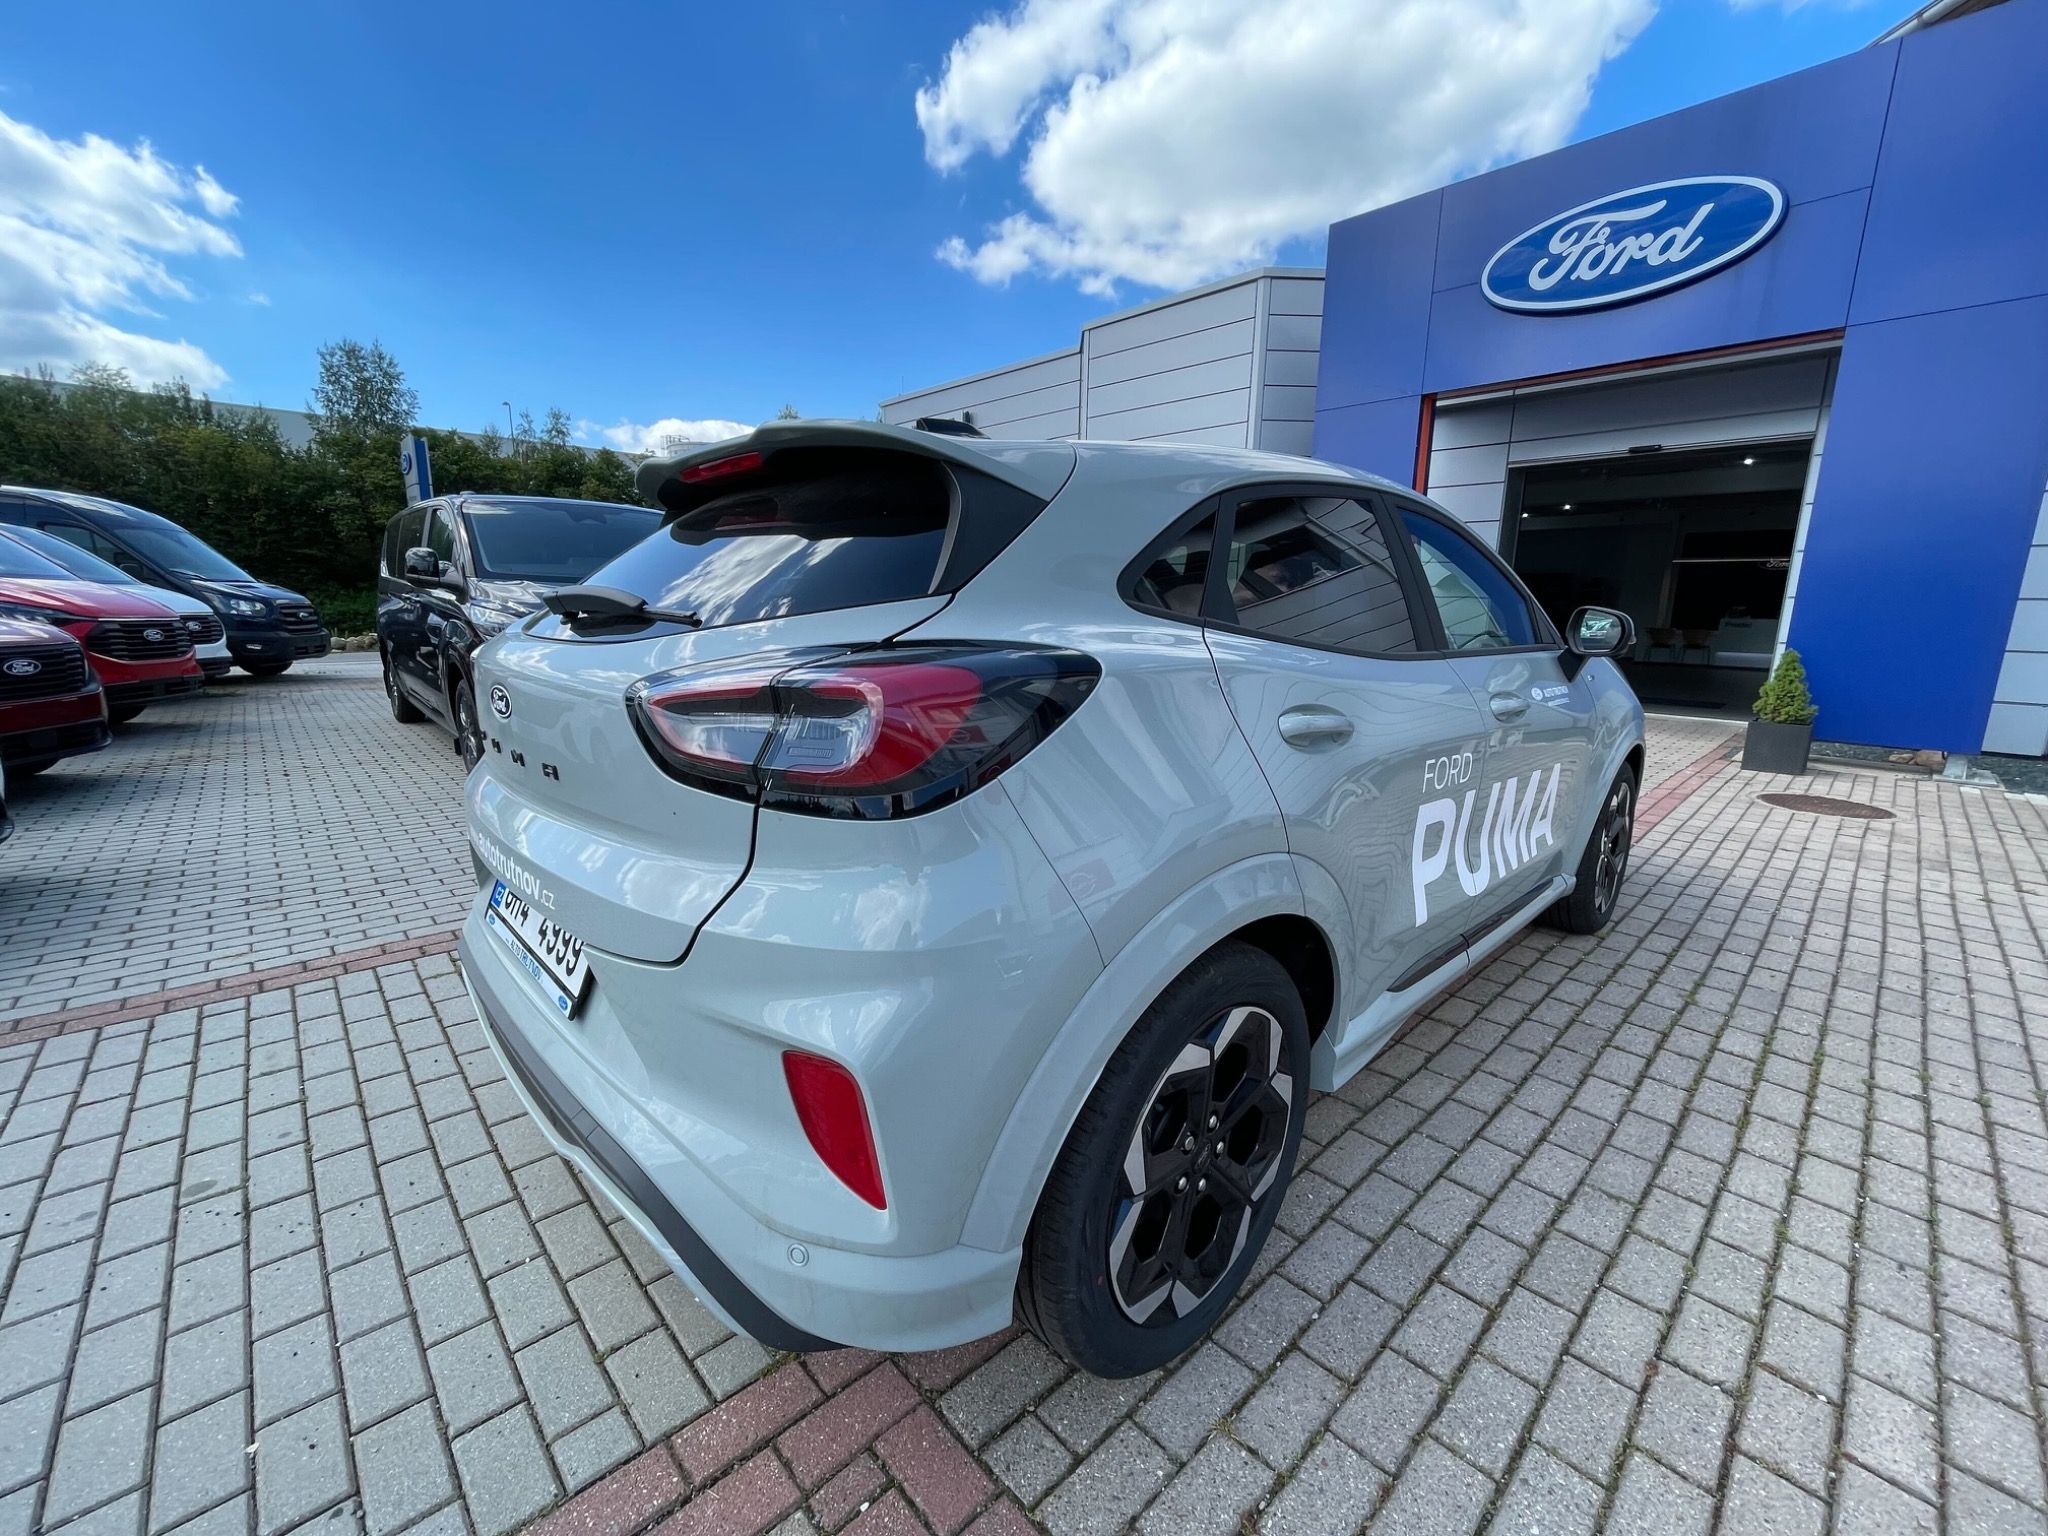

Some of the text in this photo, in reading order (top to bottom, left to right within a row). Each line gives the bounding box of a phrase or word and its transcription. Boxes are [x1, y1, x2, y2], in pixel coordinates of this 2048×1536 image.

[1528, 199, 1715, 291] Ford
[1422, 752, 1473, 793] FORD
[1412, 763, 1561, 928] PUMA
